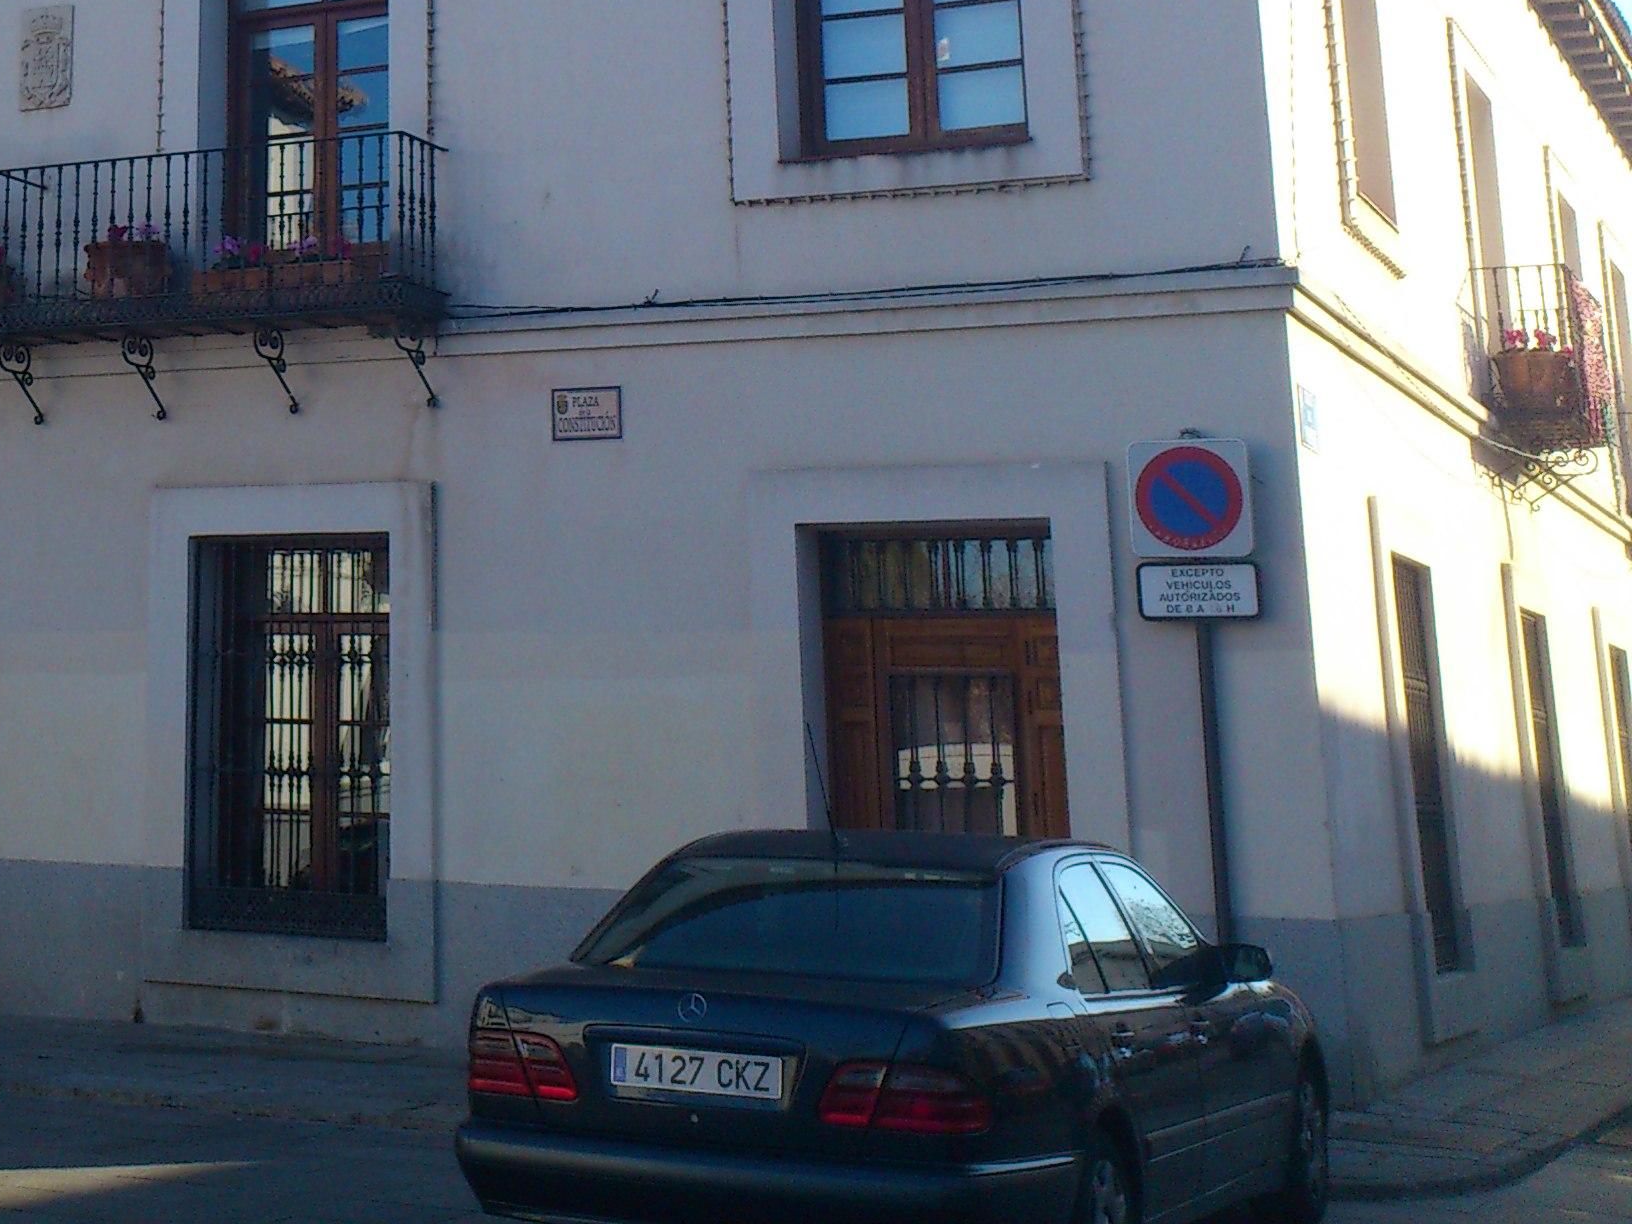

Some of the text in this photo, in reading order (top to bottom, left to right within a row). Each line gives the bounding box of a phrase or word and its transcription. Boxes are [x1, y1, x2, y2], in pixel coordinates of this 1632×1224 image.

[573, 396, 599, 407] PLAZA
[1171, 568, 1225, 577] EXCEPTO
[1166, 580, 1232, 590] VEHICULOS
[1159, 592, 1241, 602] AUTORIZADOS
[1166, 604, 1182, 614] DE
[1197, 604, 1205, 614] A
[1226, 604, 1235, 614] H
[634, 1052, 771, 1093] 4127 CKZ
